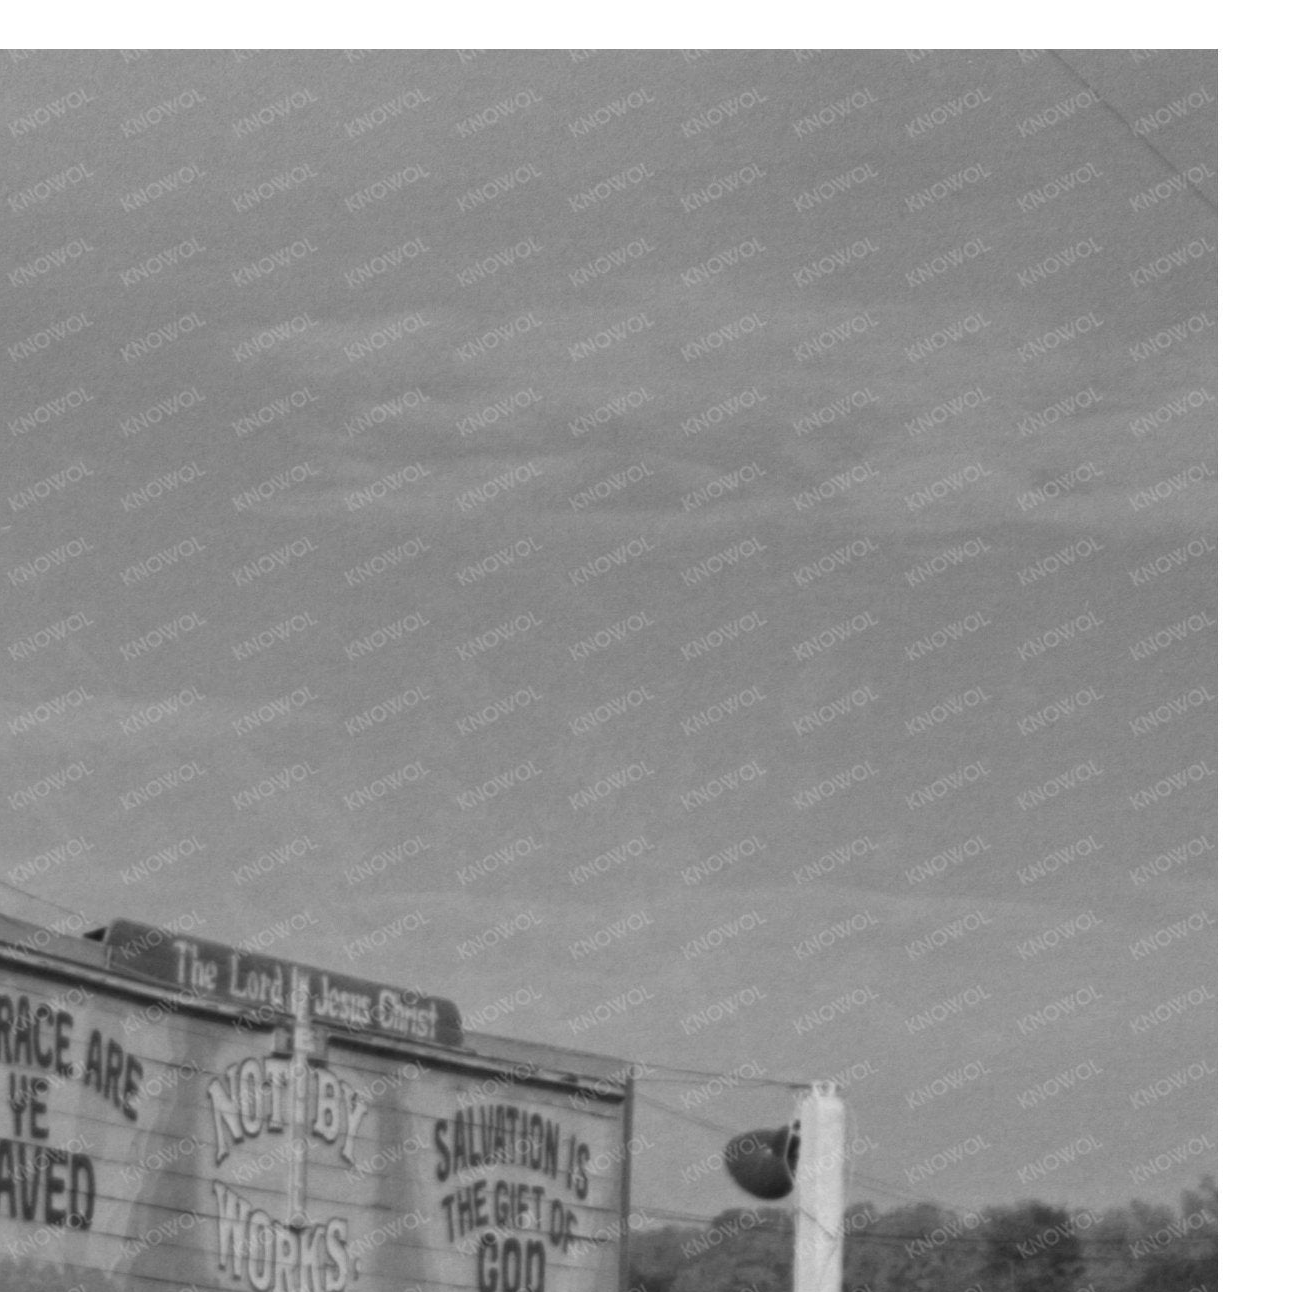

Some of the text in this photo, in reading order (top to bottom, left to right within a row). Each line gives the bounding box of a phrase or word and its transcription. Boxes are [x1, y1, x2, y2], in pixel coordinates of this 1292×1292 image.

[173, 938, 218, 990] The
[229, 953, 285, 1006] Lord
[314, 974, 372, 1025] Jesus
[378, 990, 439, 1039] Christ
[9, 1070, 50, 1140] YE
[83, 1028, 144, 1123] ARE
[207, 1056, 368, 1168] NOT BY
[433, 1104, 591, 1201] SALVATION IS
[441, 1179, 579, 1253] THE GIFT OF
